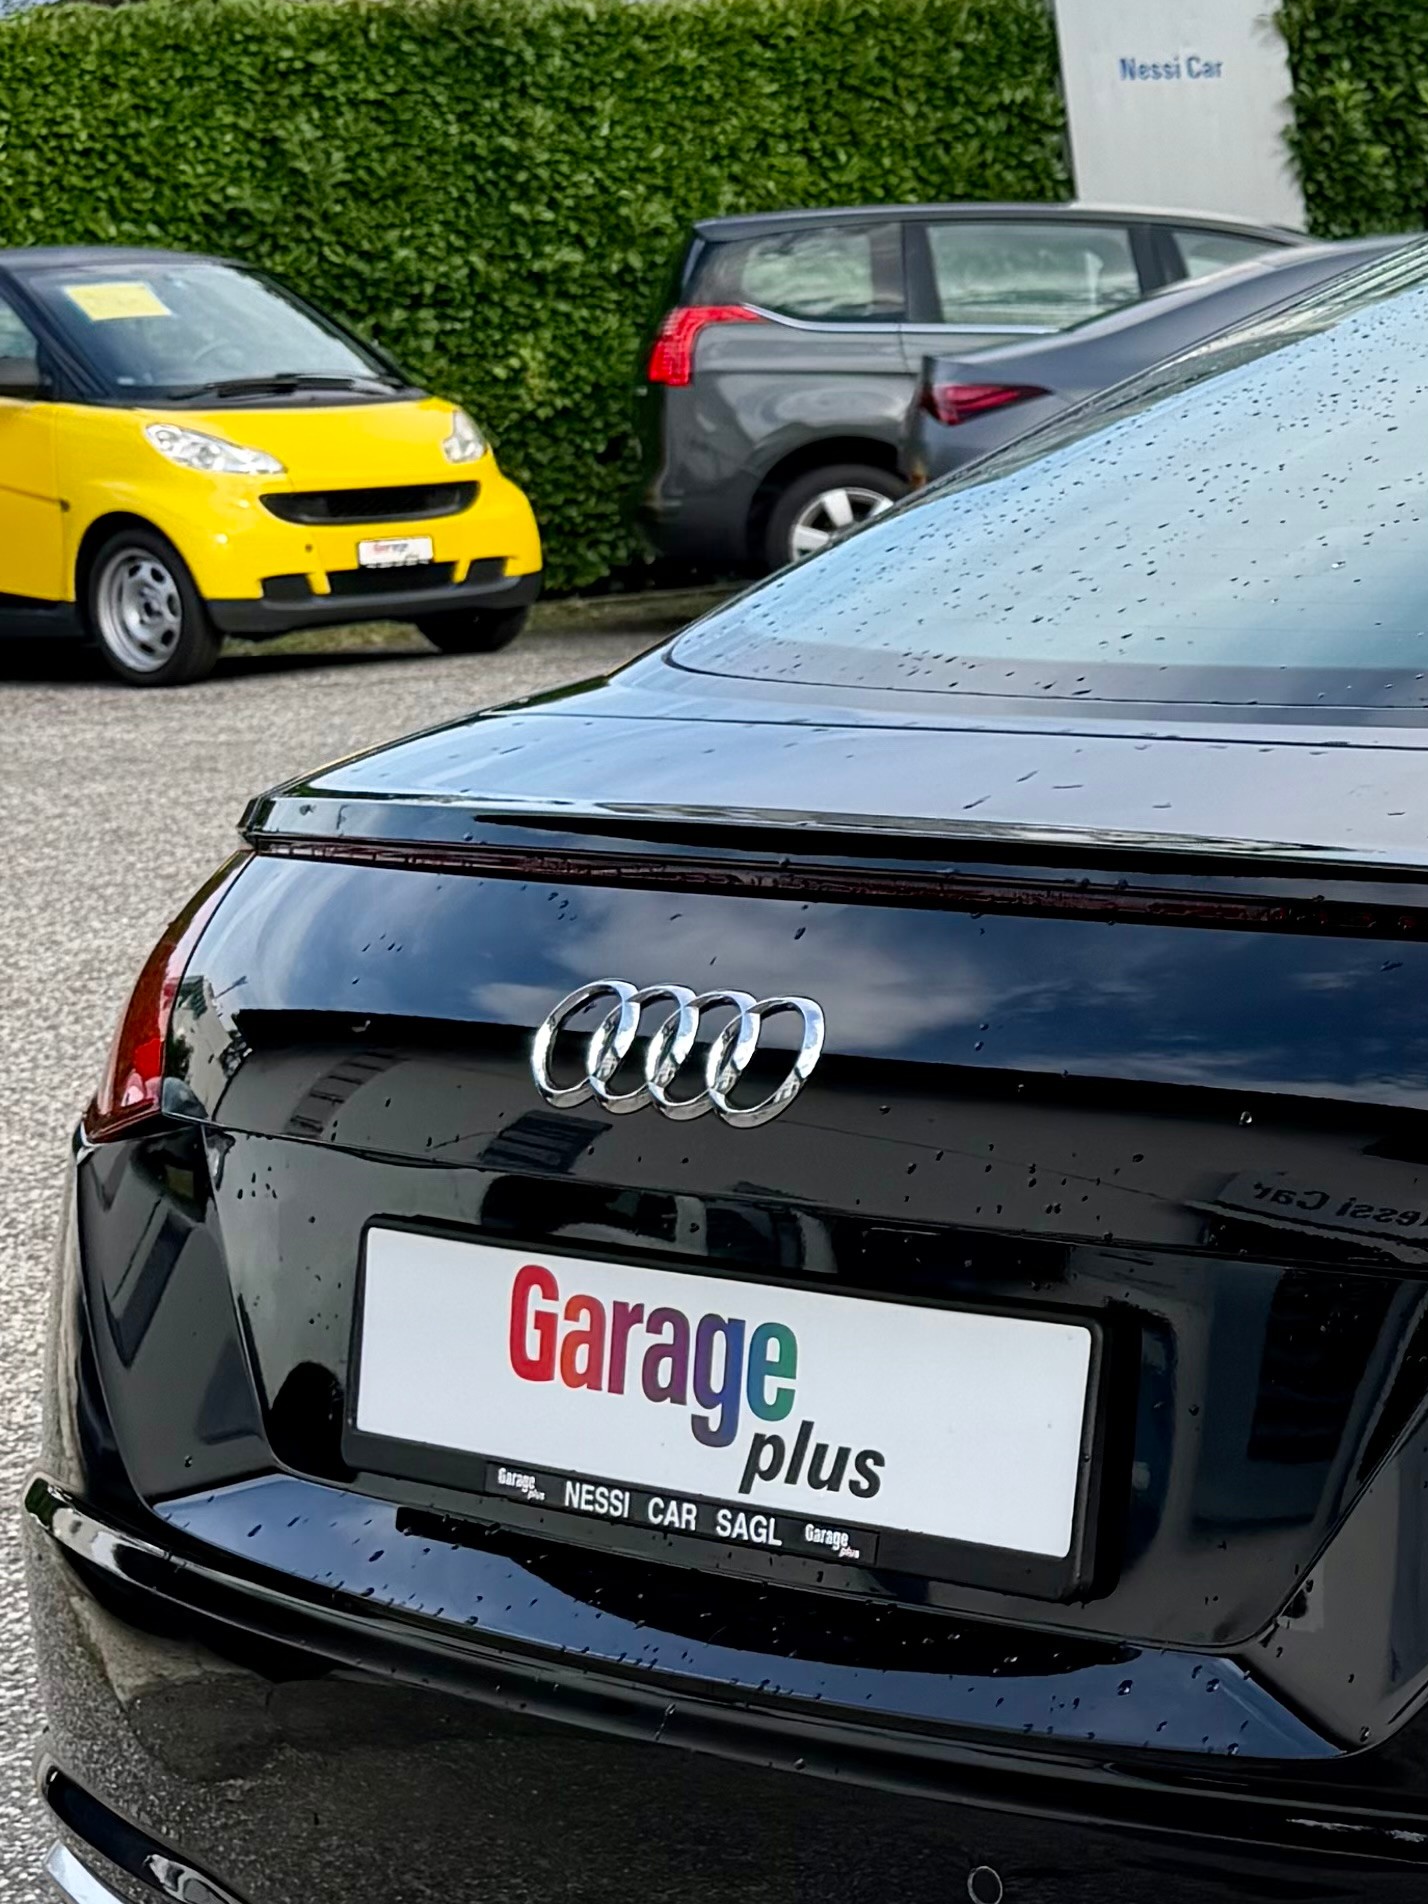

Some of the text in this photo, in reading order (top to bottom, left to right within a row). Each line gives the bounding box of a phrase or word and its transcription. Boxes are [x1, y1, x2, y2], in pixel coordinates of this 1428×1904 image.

[1119, 55, 1223, 81] Nessi Car
[509, 1263, 799, 1449] Garage
[738, 1420, 886, 1499] plus
[497, 1467, 536, 1494] Garage
[526, 1488, 546, 1502] plus
[564, 1480, 783, 1547] NESSI CAR SAGL
[804, 1523, 850, 1551] Garage
